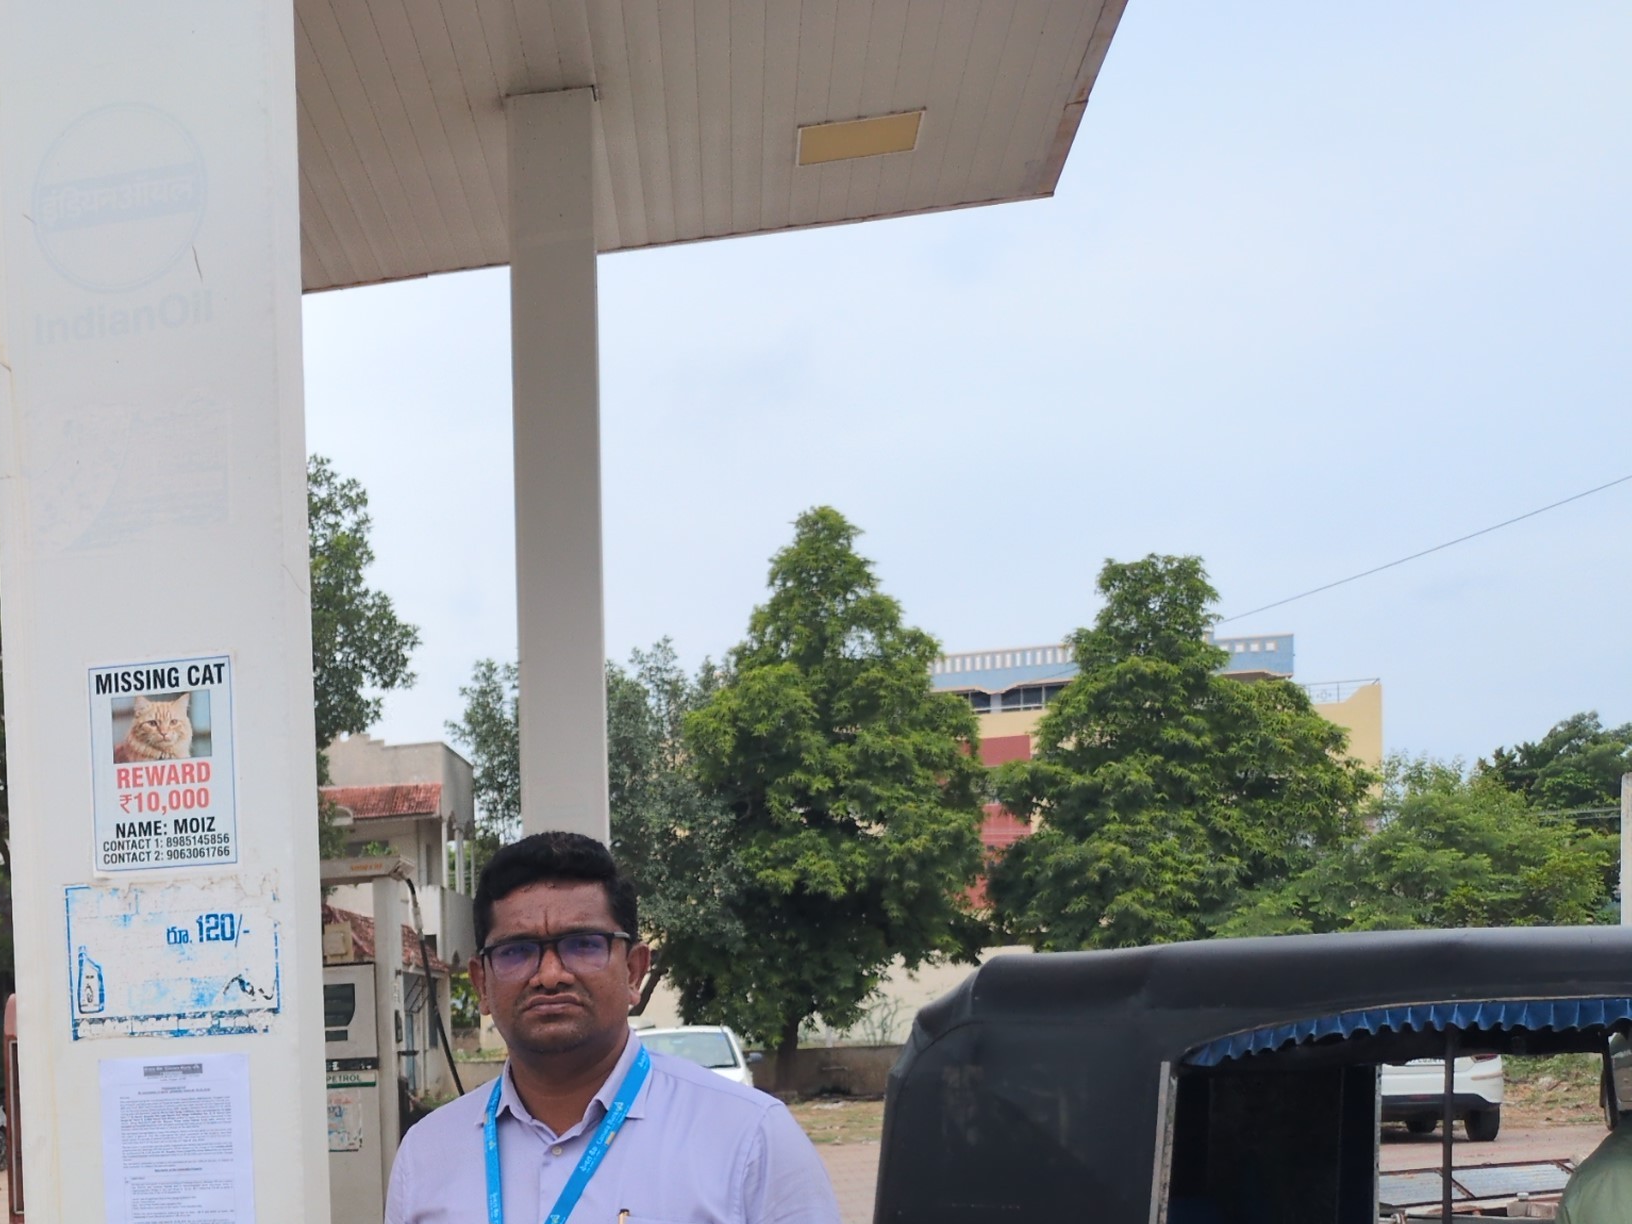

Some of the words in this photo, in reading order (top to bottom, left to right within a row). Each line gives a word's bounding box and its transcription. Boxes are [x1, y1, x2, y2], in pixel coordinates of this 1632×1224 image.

[35, 290, 214, 345] IndianOil
[95, 667, 180, 695] MISSING
[187, 663, 225, 686] CAT
[116, 762, 211, 789] REWARD
[119, 788, 210, 815] ₹10,000
[115, 820, 168, 839] NAME:
[173, 816, 216, 836] MOIZ
[103, 838, 151, 852] CONTACT
[155, 838, 163, 850] 1:
[103, 850, 152, 865] CONTACT
[154, 850, 164, 862] 2:
[196, 913, 250, 948] 120/-
[327, 1073, 362, 1083] PETROL
